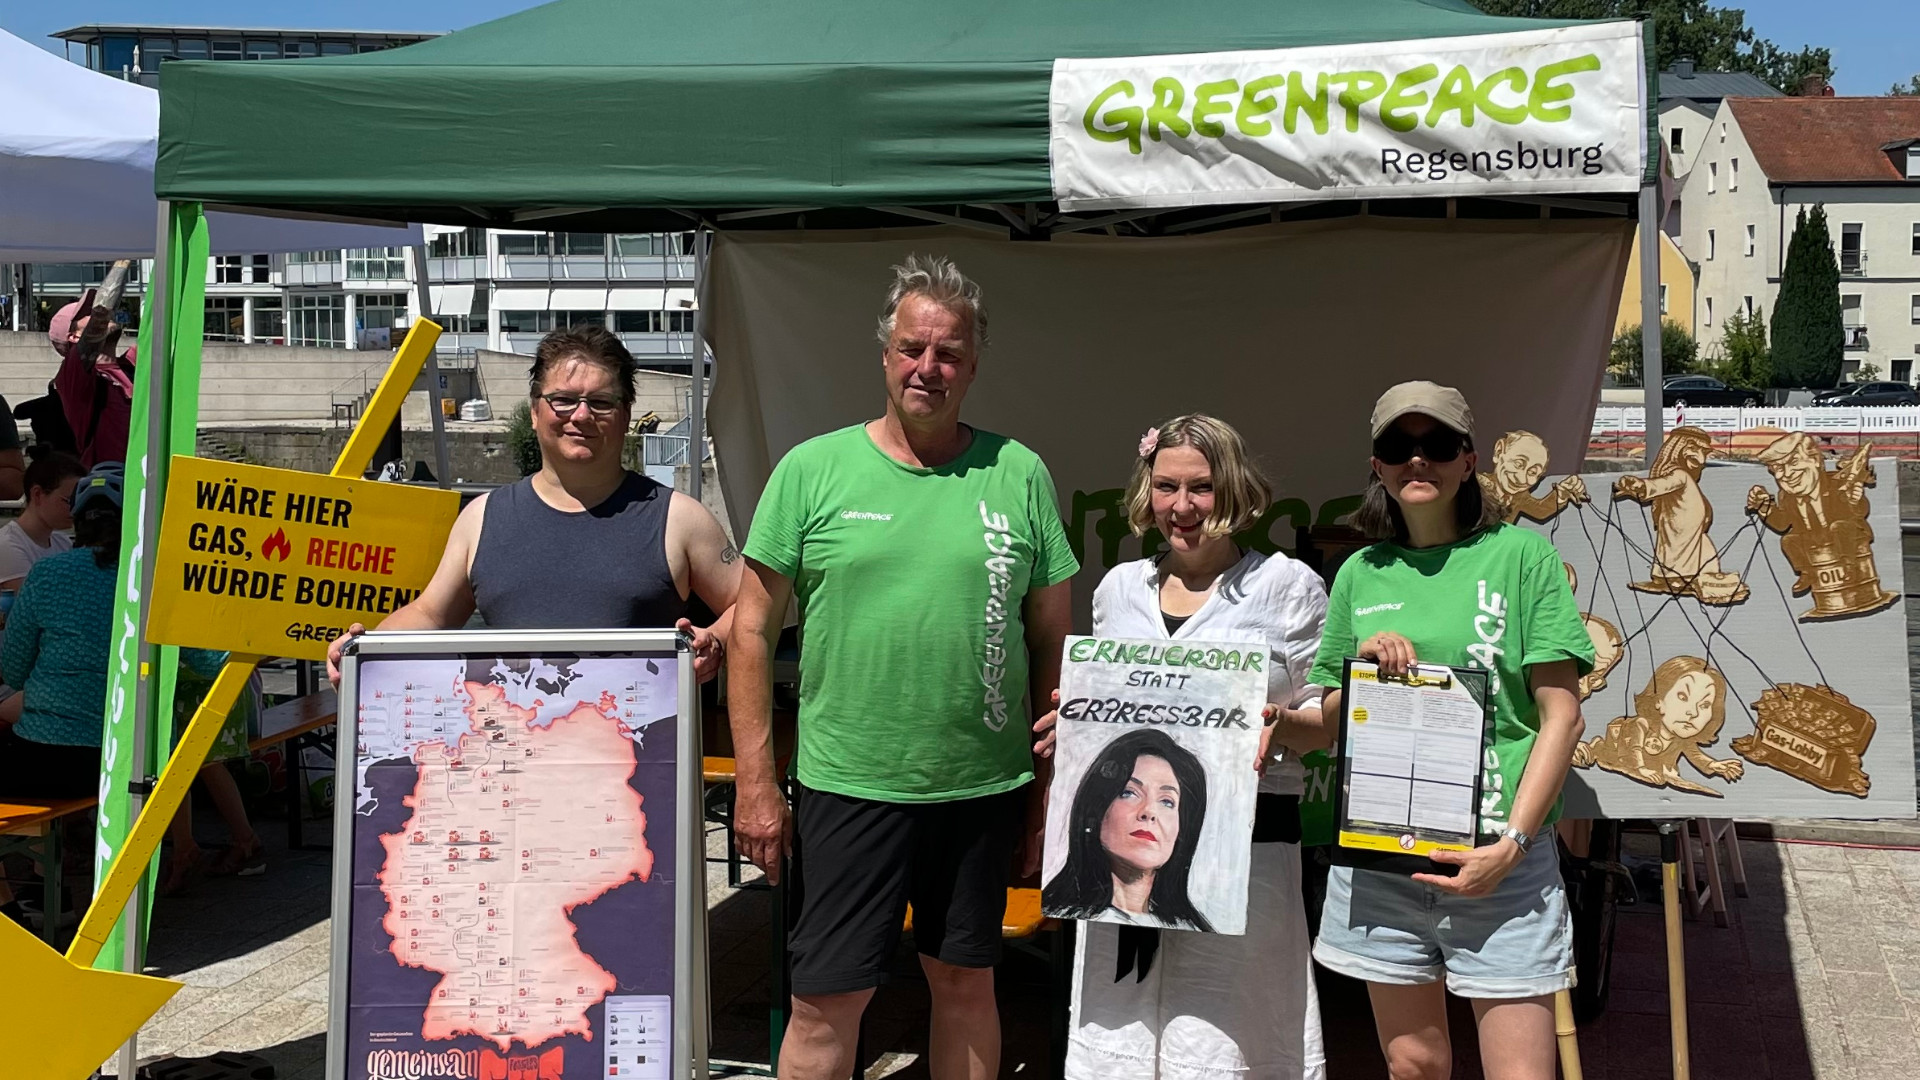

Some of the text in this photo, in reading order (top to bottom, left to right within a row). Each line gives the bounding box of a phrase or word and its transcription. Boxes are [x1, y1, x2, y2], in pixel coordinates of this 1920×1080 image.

[1083, 53, 1601, 155] GREENPEACE
[1381, 141, 1604, 181] Regensburg
[196, 477, 353, 528] WÄRE HIER
[840, 509, 894, 521] GREENPEACE
[188, 522, 396, 575] GAS, REICHE
[183, 559, 287, 602] WÜRDE
[1819, 569, 1844, 586] OIL
[977, 500, 1016, 732] GREENPEACE
[1069, 638, 1264, 673] ERNEUERBAR
[1125, 670, 1191, 690] STATT
[1059, 697, 1251, 731] ERPRESSBAR
[1764, 726, 1824, 766] Gas-Lobby
[367, 1047, 479, 1080] gemeinsam
